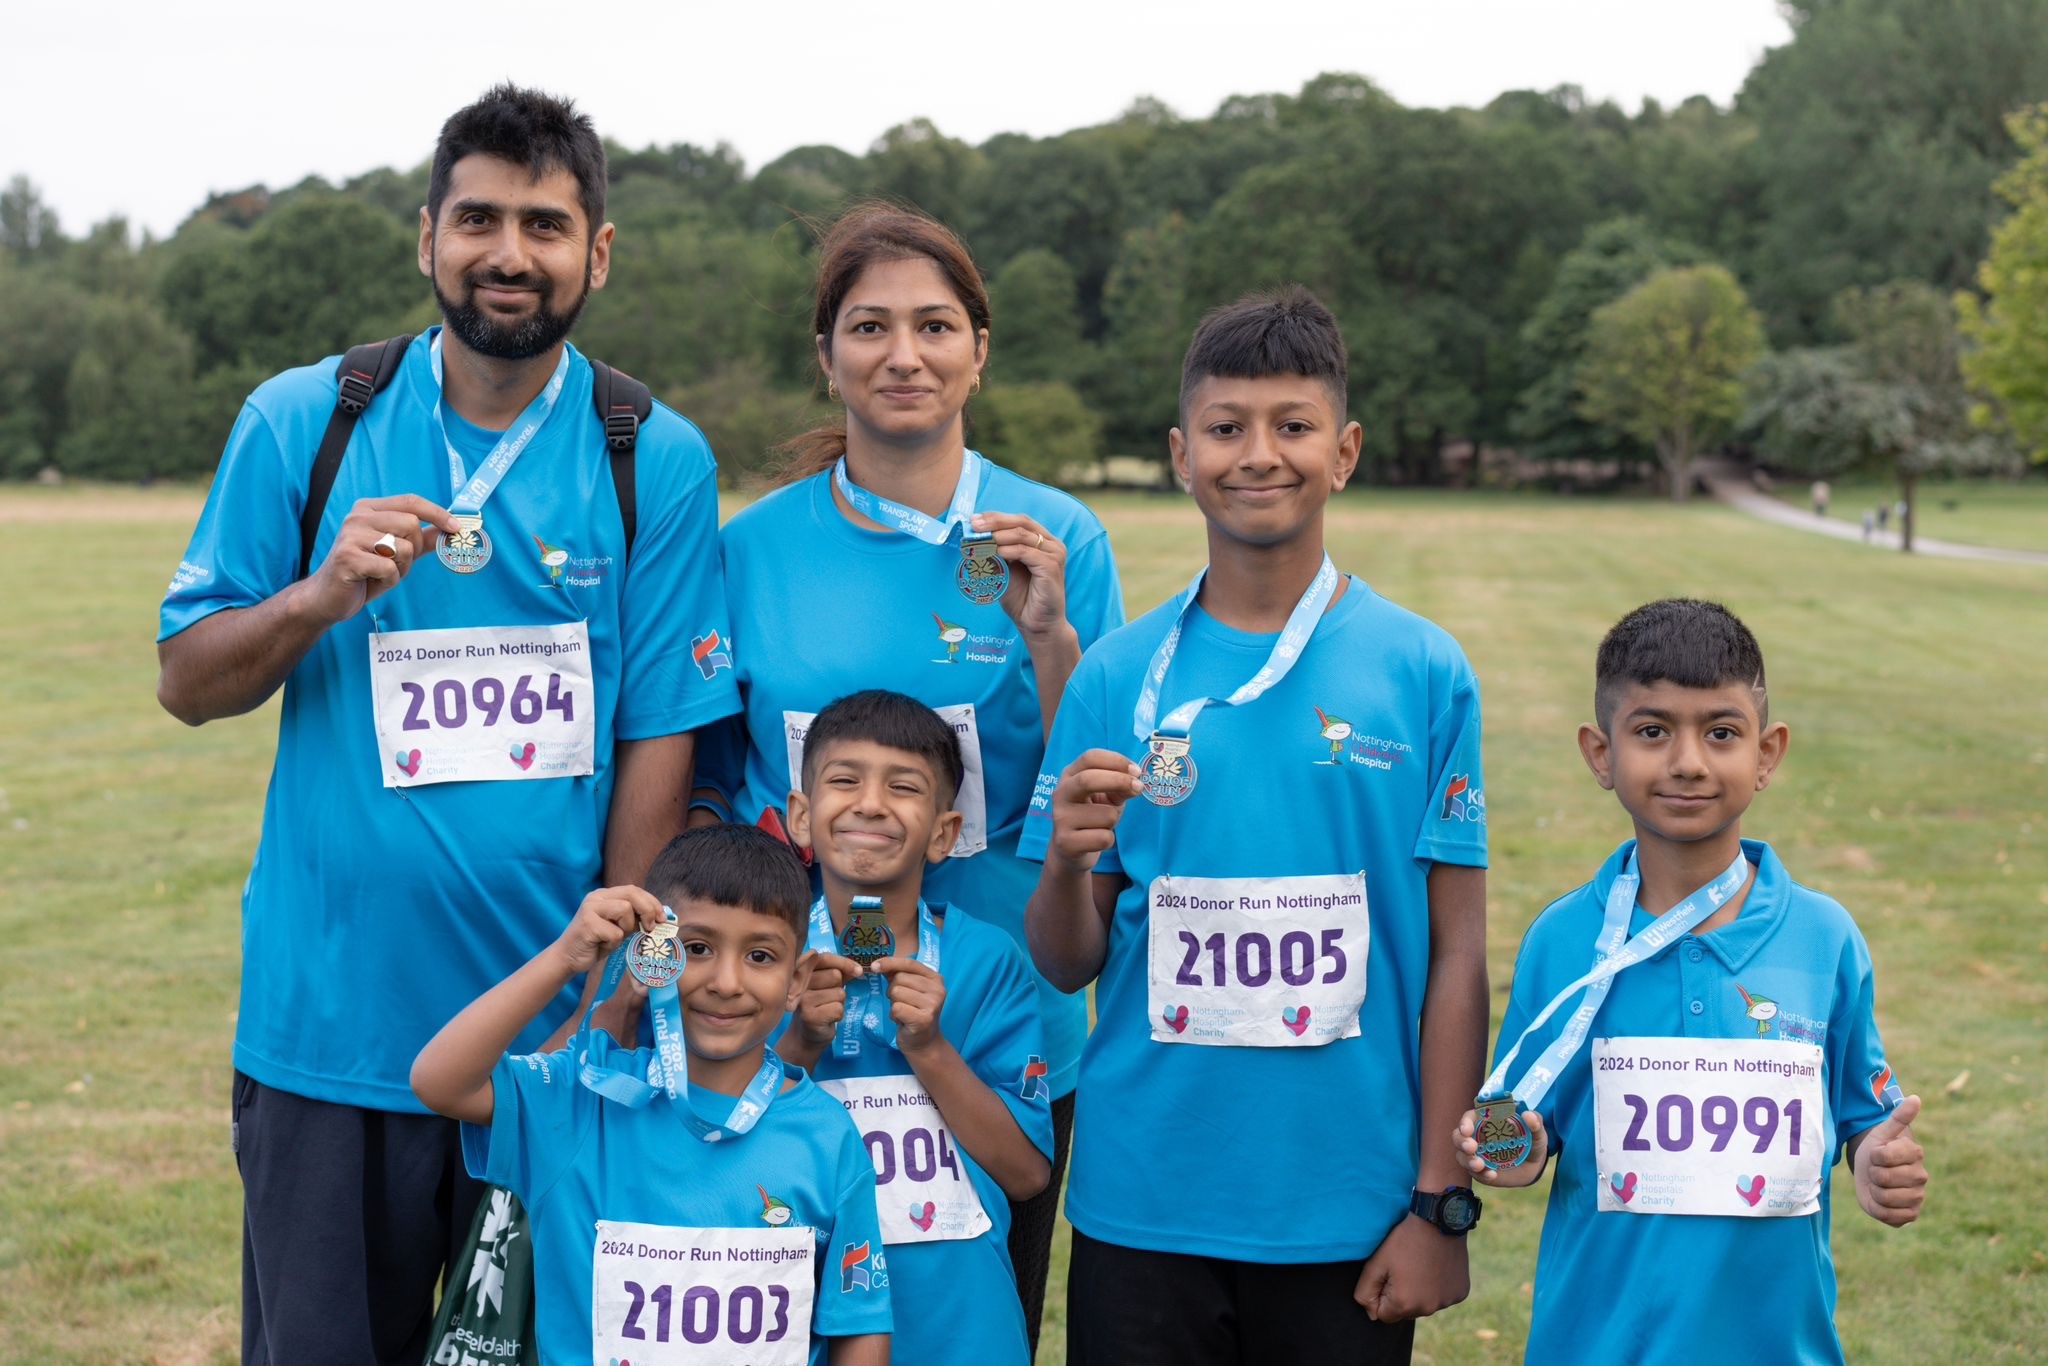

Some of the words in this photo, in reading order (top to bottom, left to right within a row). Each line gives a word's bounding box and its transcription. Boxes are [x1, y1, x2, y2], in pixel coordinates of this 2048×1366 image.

[878, 501, 930, 527] TRANSPLANT
[959, 575, 1007, 589] DONOR
[970, 584, 998, 597] RUN
[377, 648, 412, 663] 2024
[416, 647, 462, 660] Donor
[465, 644, 496, 657] Run
[499, 640, 581, 657] Nottingham
[965, 651, 1007, 663] Hospital
[400, 672, 574, 732] 20964
[790, 727, 809, 742] 202
[1351, 731, 1412, 752] Nottingham
[540, 761, 569, 772] Charity
[1350, 753, 1392, 770] Hospital
[1138, 773, 1193, 788] DONOR
[1150, 784, 1180, 798] RUN
[1156, 893, 1187, 909] 2024
[1190, 896, 1235, 910] Donor
[1239, 896, 1272, 910] Run
[1276, 892, 1361, 910] Nottingham
[816, 909, 831, 935] RUN
[1656, 902, 1696, 933] Westfield
[631, 953, 683, 971] DONOR
[1175, 928, 1348, 988] 21005
[641, 965, 671, 978] RUN
[645, 979, 664, 987] 2024
[844, 995, 860, 1039] Westfield
[1192, 1006, 1245, 1017] Nottingham
[654, 1007, 670, 1041] RUN
[1192, 1017, 1234, 1029] Hospitals
[1315, 1026, 1342, 1038] Charity
[1778, 1020, 1825, 1042] Children's
[1193, 1027, 1226, 1039] Charity
[671, 1031, 685, 1073] 2024
[658, 1041, 677, 1101] DONOR
[1599, 1056, 1634, 1072] 2024
[1639, 1056, 1690, 1072] Donor
[1694, 1058, 1728, 1073] Run
[1733, 1058, 1815, 1078] Nottingham
[862, 1095, 893, 1109] Run
[897, 1092, 939, 1110] Nottin
[1622, 1093, 1803, 1156] 20991
[1476, 1136, 1529, 1155] DONOR
[1488, 1148, 1518, 1161] RUN
[862, 1127, 961, 1186] 004
[1641, 1172, 1696, 1185] Nottingham
[1641, 1184, 1684, 1197] Hospitals
[1641, 1195, 1676, 1207] Charity
[1767, 1198, 1795, 1210] Charity
[940, 1220, 966, 1233] Charity
[601, 1240, 634, 1256] 2024
[638, 1244, 686, 1261] Donor
[690, 1247, 722, 1261] Run
[727, 1246, 808, 1264] Nottingham
[621, 1280, 790, 1345] 21003
